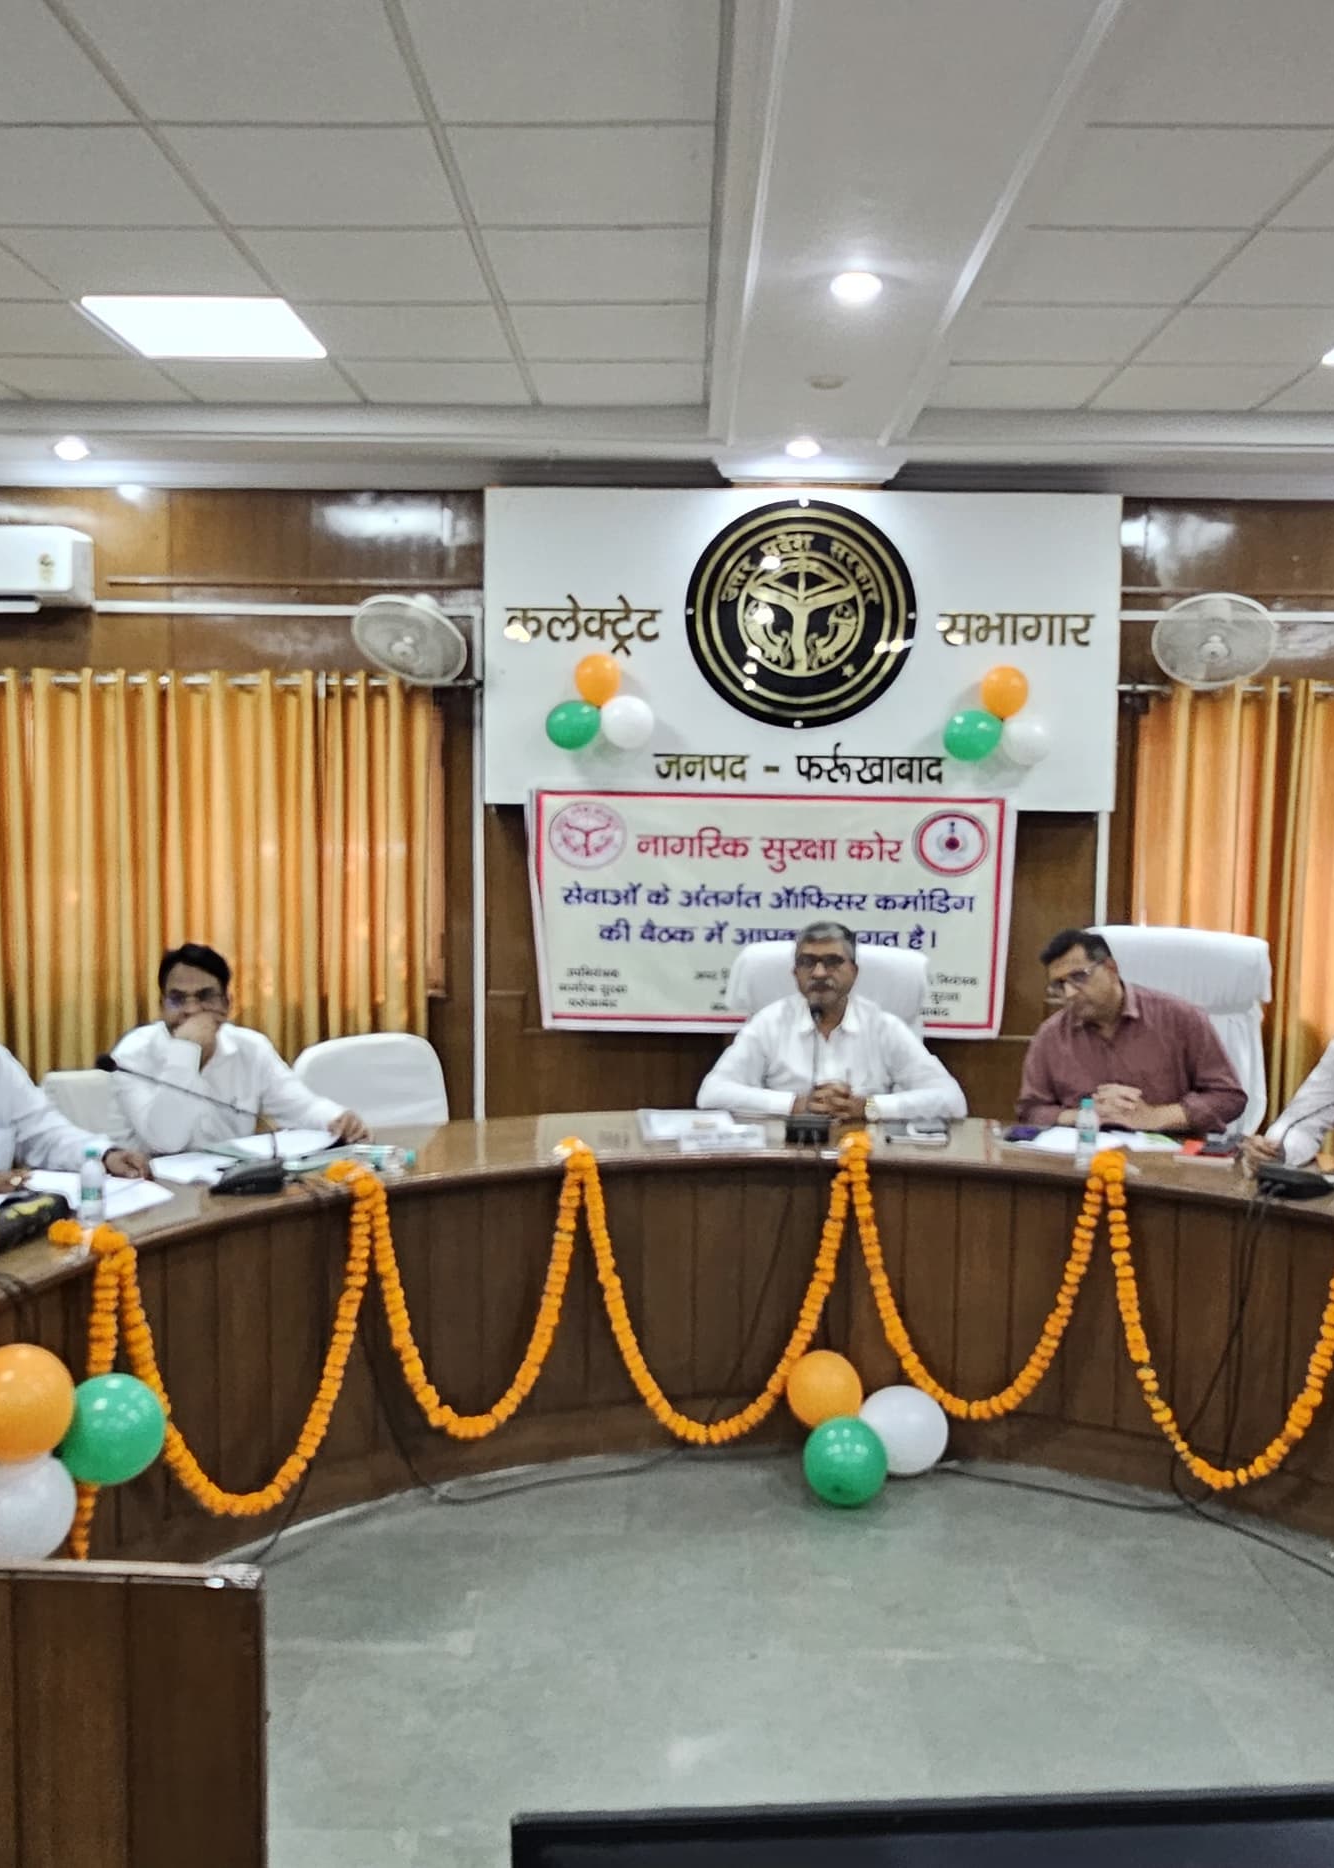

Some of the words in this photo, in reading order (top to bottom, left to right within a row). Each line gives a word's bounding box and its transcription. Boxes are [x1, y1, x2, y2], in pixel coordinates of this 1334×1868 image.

[505, 593, 663, 656] कलेक्ट्रेट
[937, 612, 1096, 646] सभागार
[653, 753, 750, 781] जनपद
[636, 826, 751, 858] नागरिक
[760, 835, 838, 873] सुरक्षा
[845, 831, 904, 863] कोर
[647, 882, 671, 906] के
[678, 883, 762, 909] अंतर्गत
[598, 917, 631, 943] की
[639, 918, 698, 943] बैठक
[703, 920, 729, 945] में
